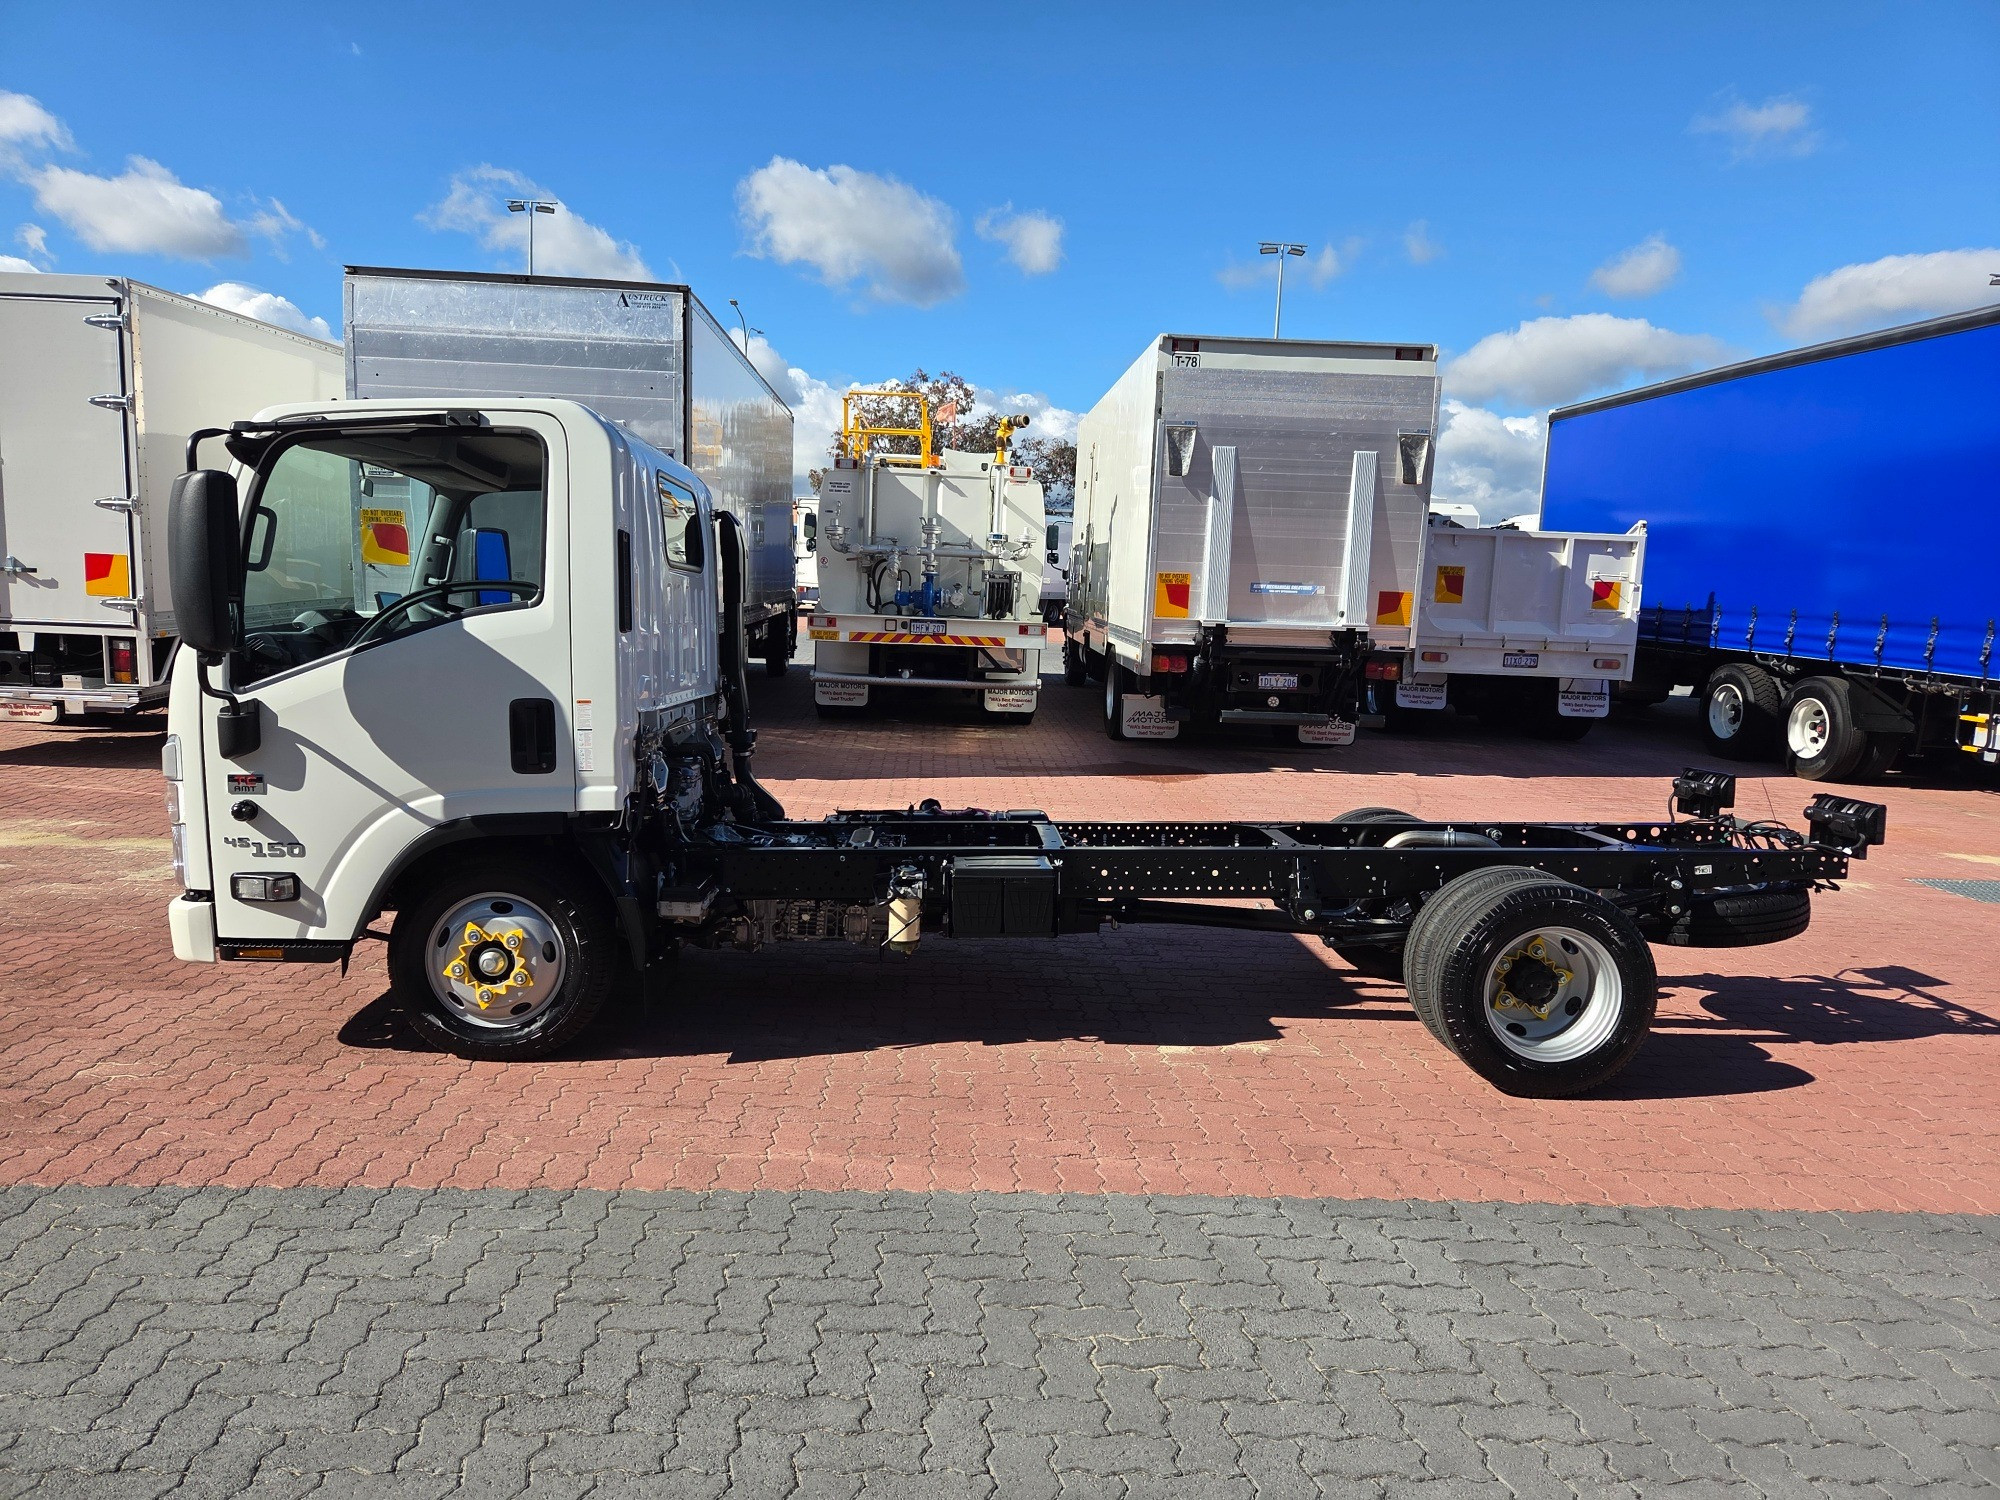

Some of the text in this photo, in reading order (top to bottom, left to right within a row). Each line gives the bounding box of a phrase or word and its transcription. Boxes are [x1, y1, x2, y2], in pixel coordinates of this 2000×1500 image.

[616, 291, 667, 307] AUSTRUCK
[1175, 355, 1198, 368] T-78
[223, 836, 307, 858] 45 150
